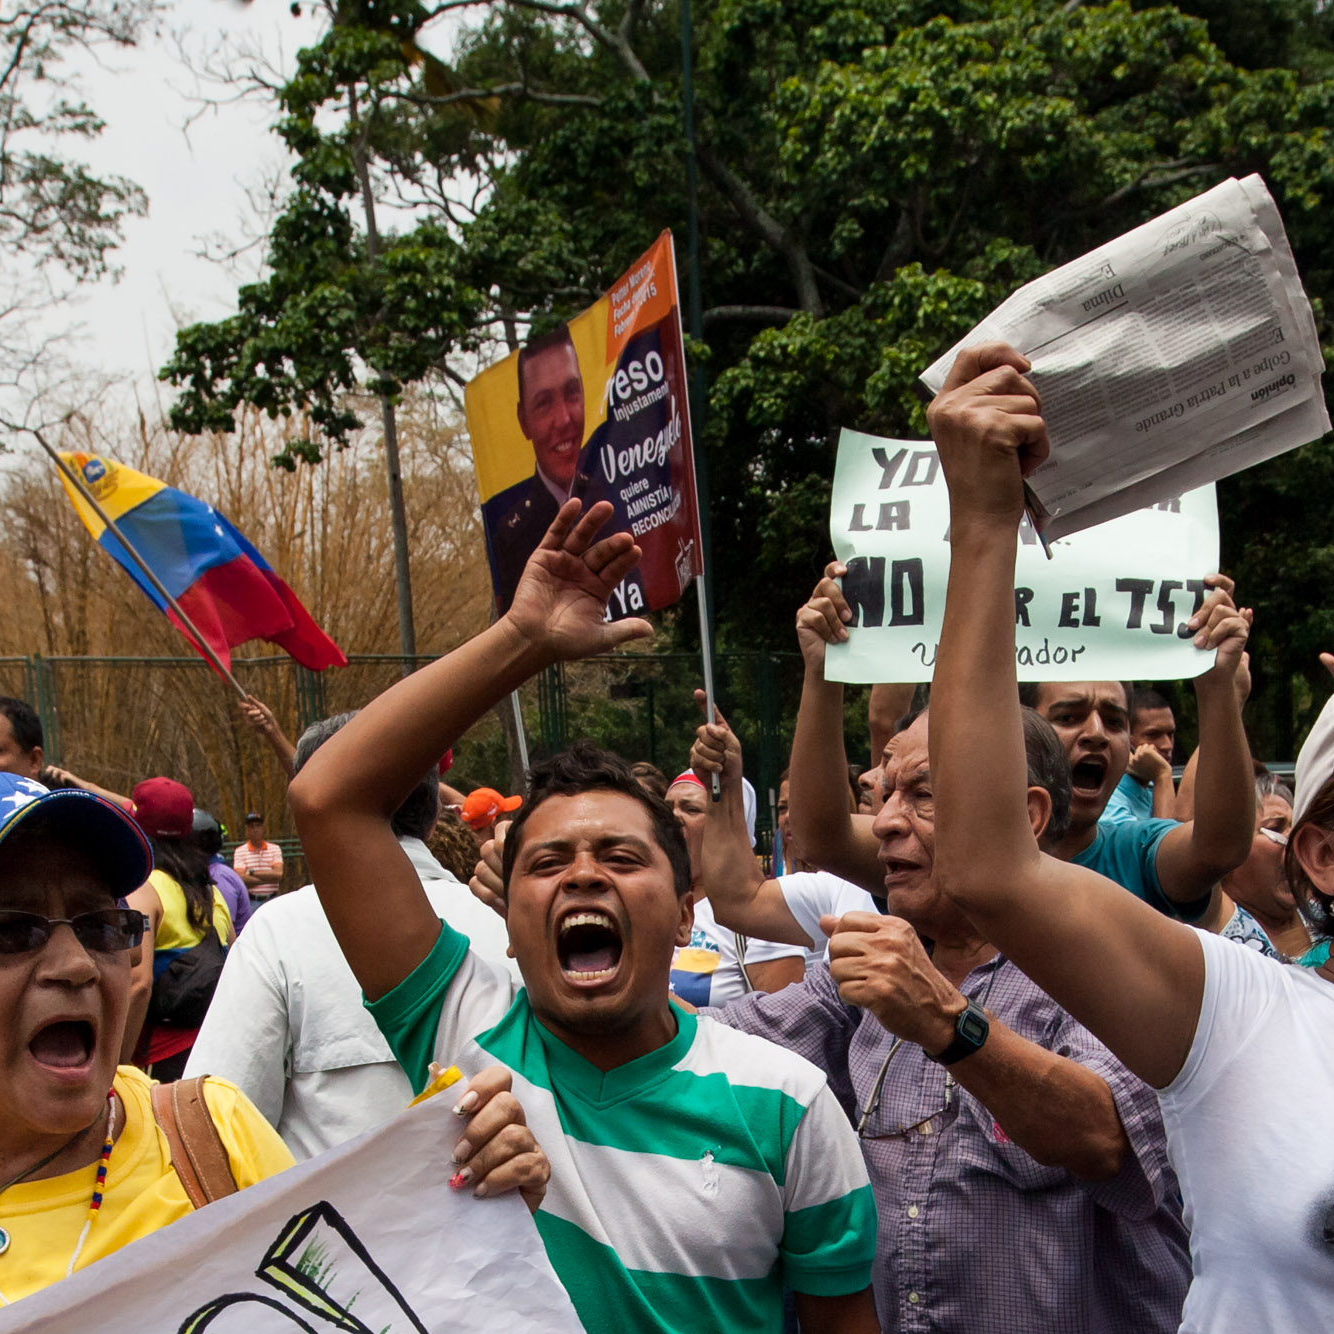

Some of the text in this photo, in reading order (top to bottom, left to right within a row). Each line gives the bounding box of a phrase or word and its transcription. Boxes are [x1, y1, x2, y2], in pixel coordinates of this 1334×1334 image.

[1081, 283, 1125, 313] Dilma
[1243, 370, 1252, 380] a
[1253, 351, 1291, 376] Golpe
[1228, 374, 1241, 387] la
[1251, 373, 1296, 401] Opinión
[1187, 382, 1227, 408] Patria
[1135, 403, 1185, 433] Grande
[871, 446, 940, 490] YO
[620, 476, 650, 501] quiere
[847, 500, 911, 532] LA
[844, 555, 924, 628] NO
[1058, 587, 1101, 628] EL
